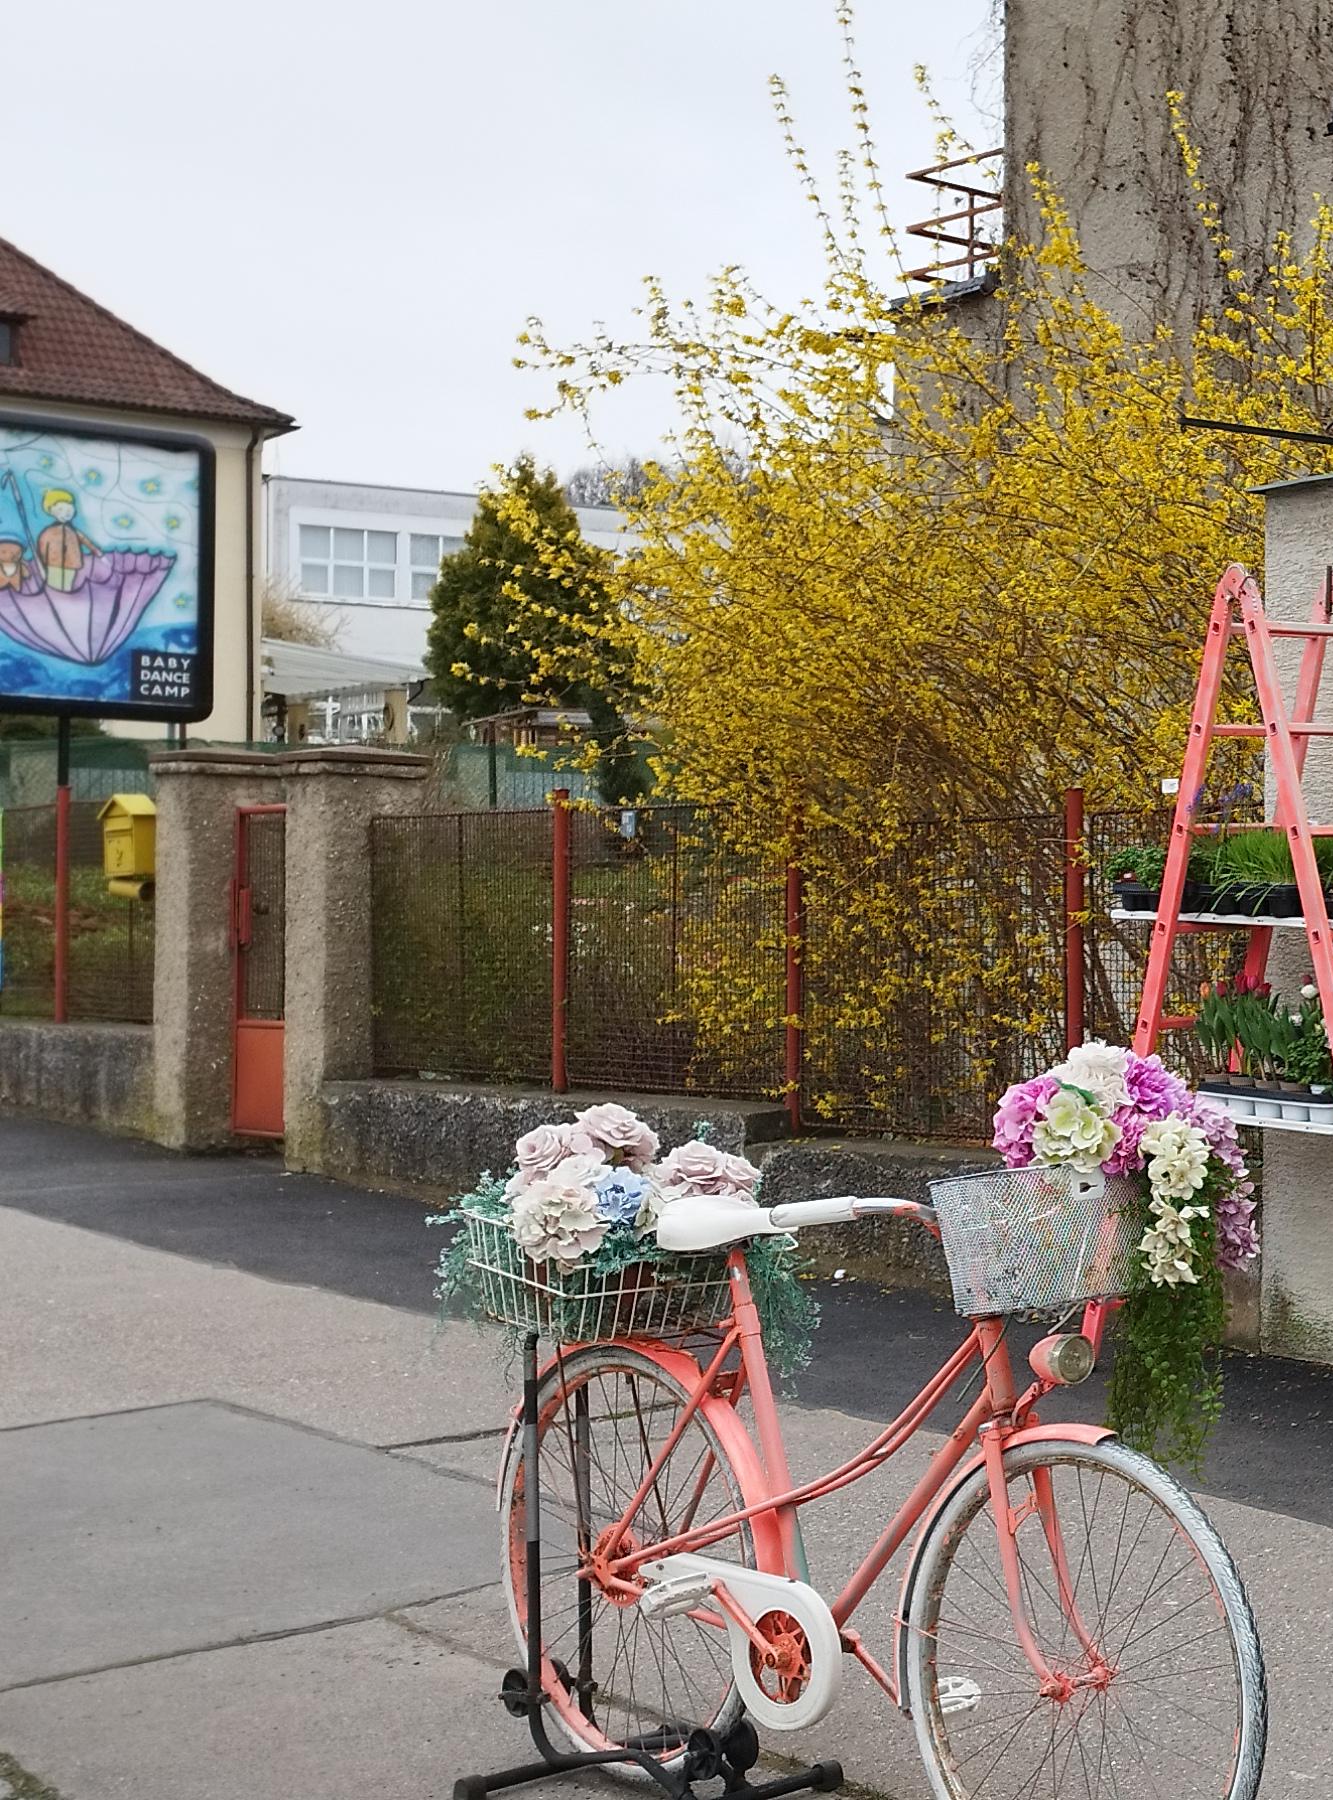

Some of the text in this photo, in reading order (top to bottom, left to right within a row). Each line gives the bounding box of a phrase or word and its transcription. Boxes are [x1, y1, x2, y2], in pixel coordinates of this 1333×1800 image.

[141, 655, 190, 670] BABY
[140, 670, 190, 684] DANCE
[140, 683, 190, 699] CAMP
